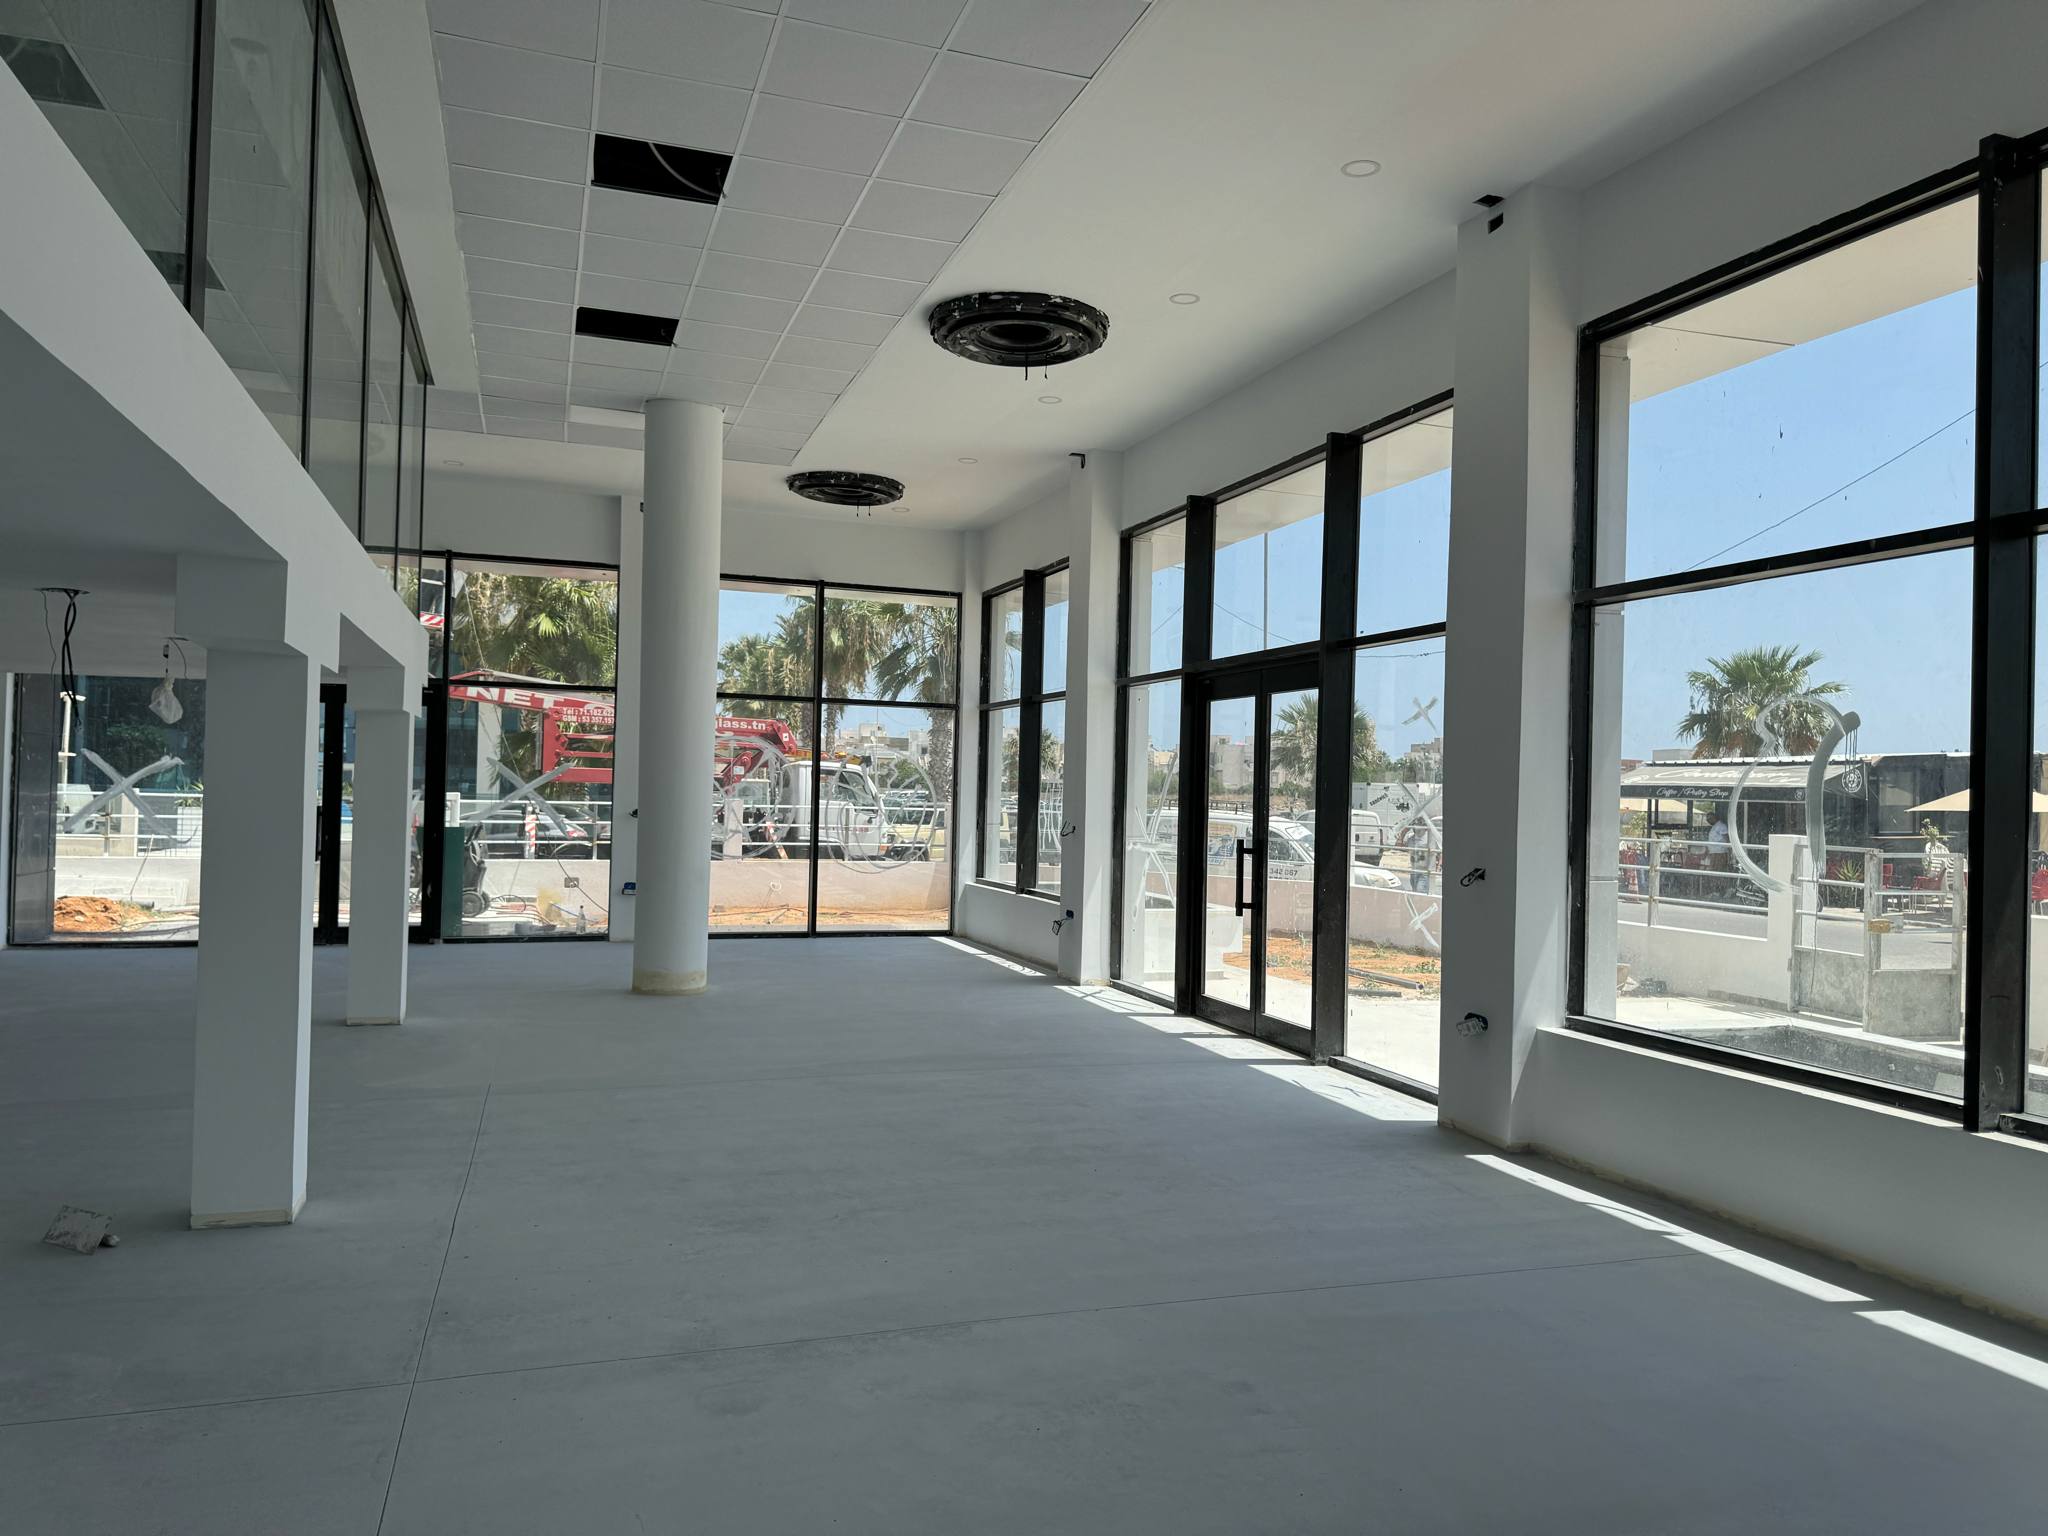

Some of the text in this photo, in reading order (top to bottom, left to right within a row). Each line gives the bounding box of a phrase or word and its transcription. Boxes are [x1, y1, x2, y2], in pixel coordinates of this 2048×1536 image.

[466, 686, 565, 709] NET
[563, 707, 574, 715] Tel
[563, 714, 577, 722] GSM
[715, 718, 766, 730] lass.tn
[1656, 787, 1677, 797] Coffee
[1709, 788, 1729, 798] Shop
